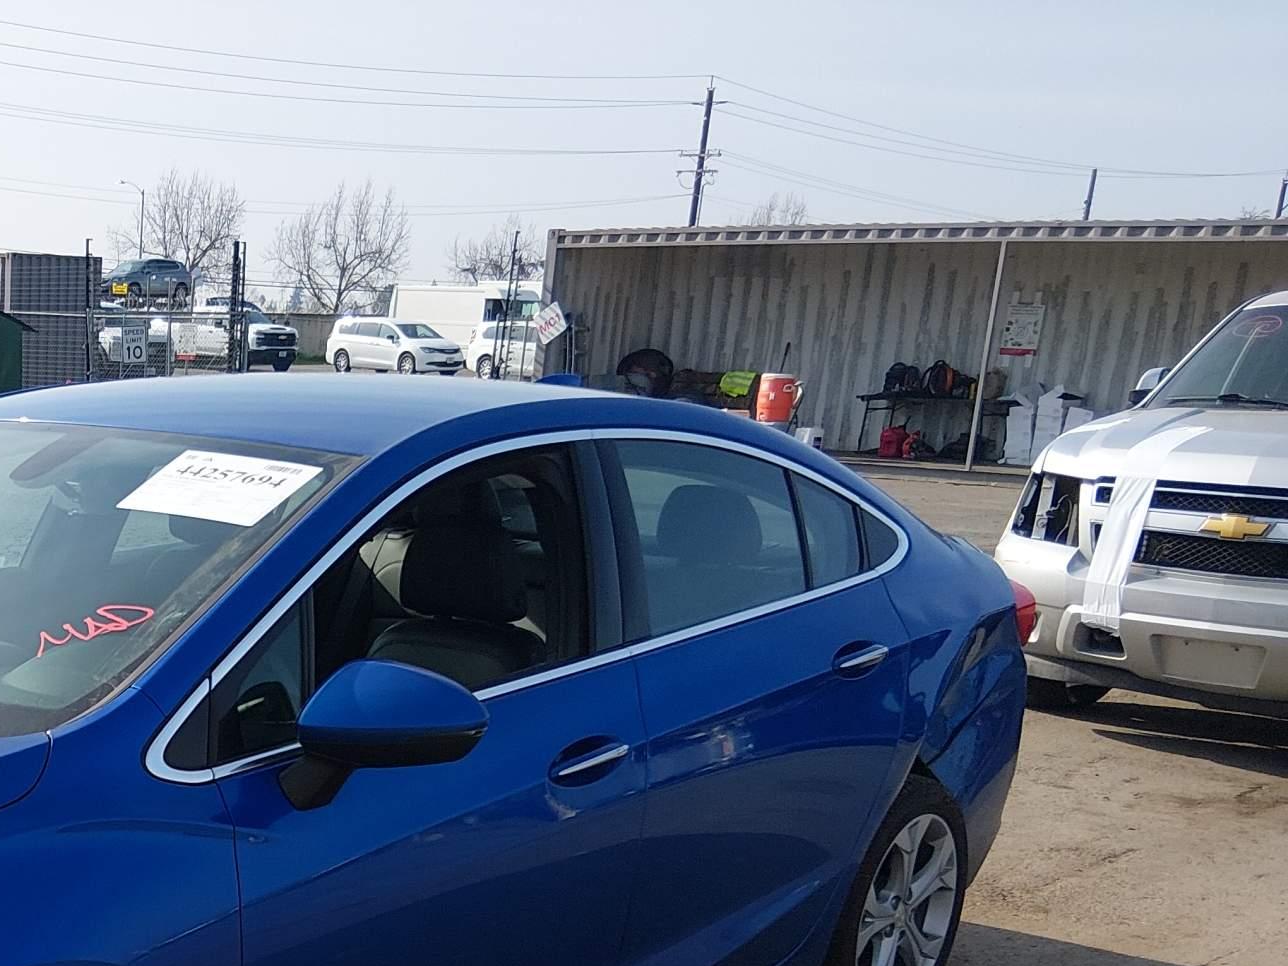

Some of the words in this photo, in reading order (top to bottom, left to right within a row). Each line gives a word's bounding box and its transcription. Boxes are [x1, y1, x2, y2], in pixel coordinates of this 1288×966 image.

[124, 328, 144, 336] SPEED
[126, 345, 143, 360] 10
[176, 464, 288, 489] 44257694
